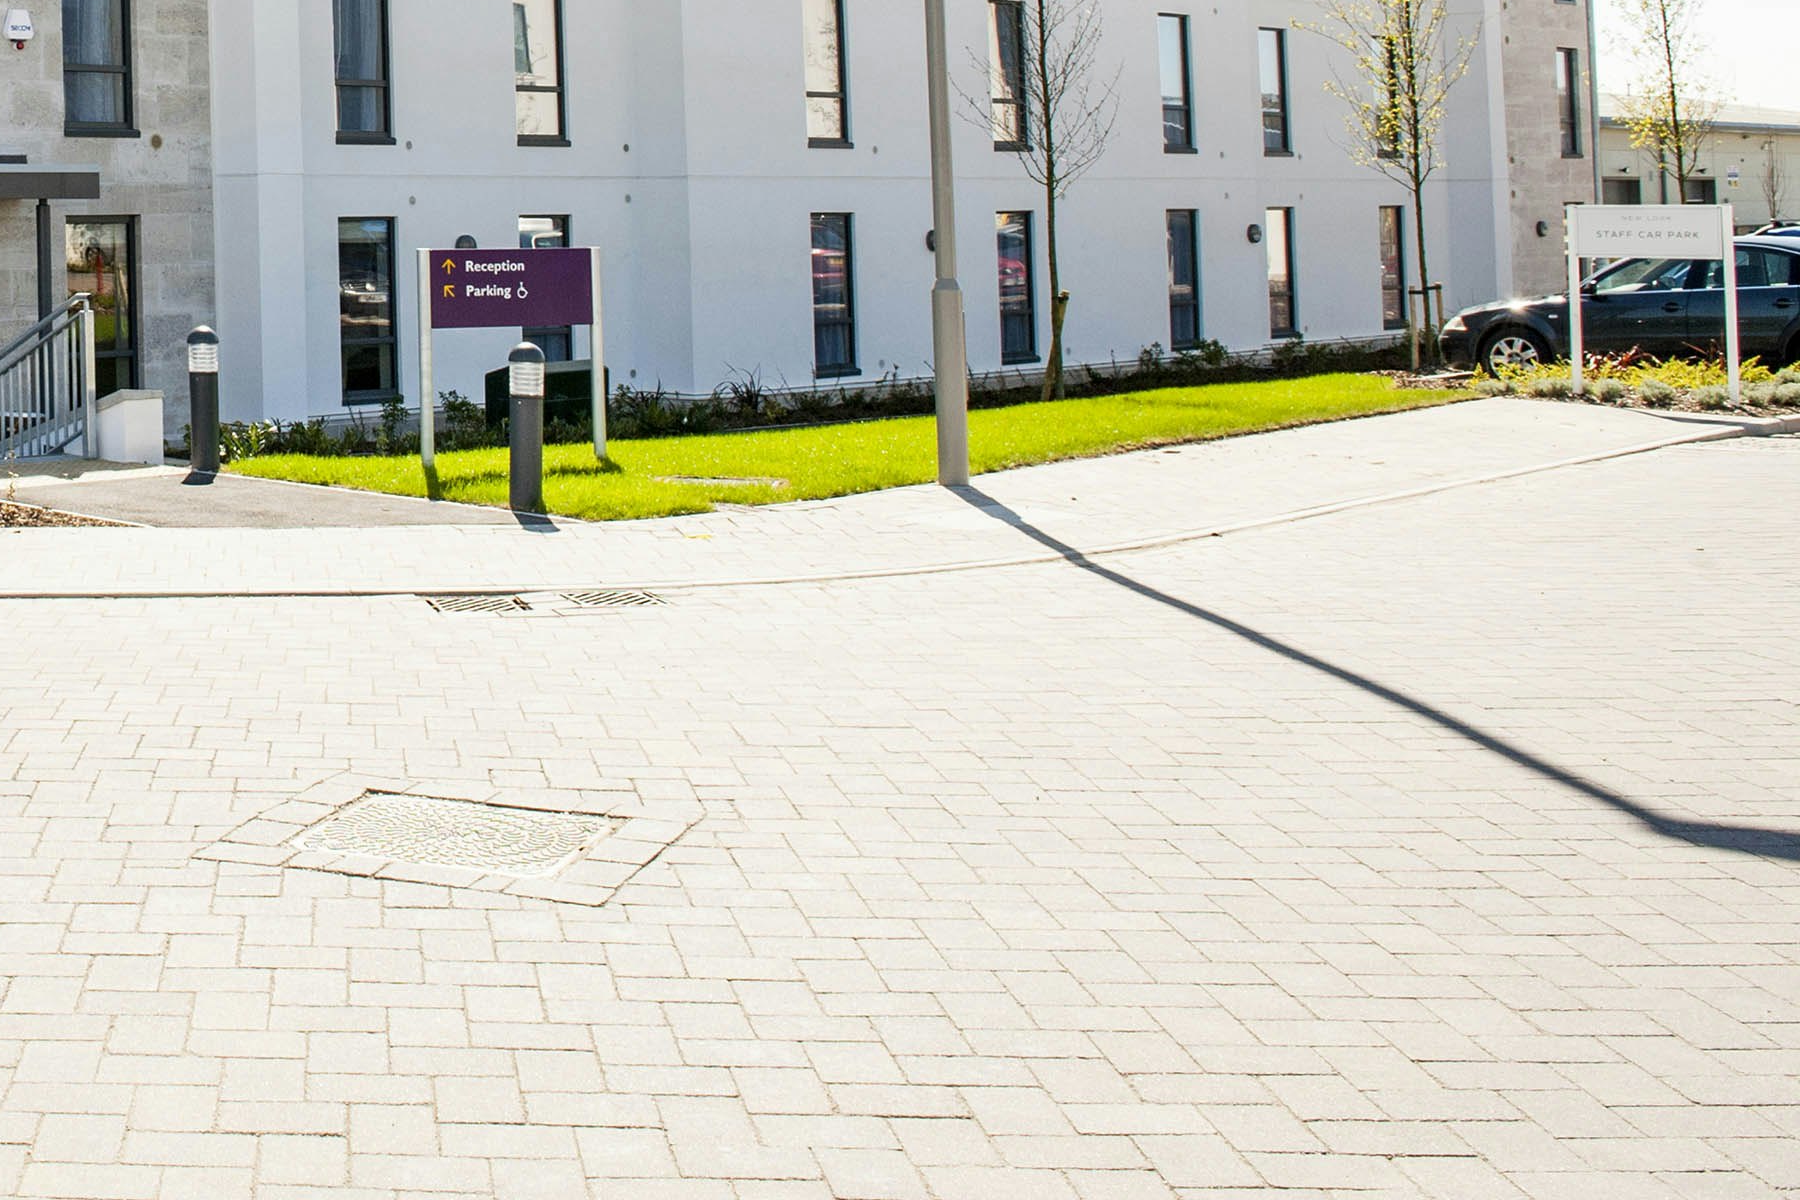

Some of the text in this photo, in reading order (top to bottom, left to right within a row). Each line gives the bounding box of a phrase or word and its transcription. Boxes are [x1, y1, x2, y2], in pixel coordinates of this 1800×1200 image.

[1595, 230, 1699, 239] STAFF CAR PARK
[465, 259, 525, 275] Reception
[465, 284, 512, 299] Parking
